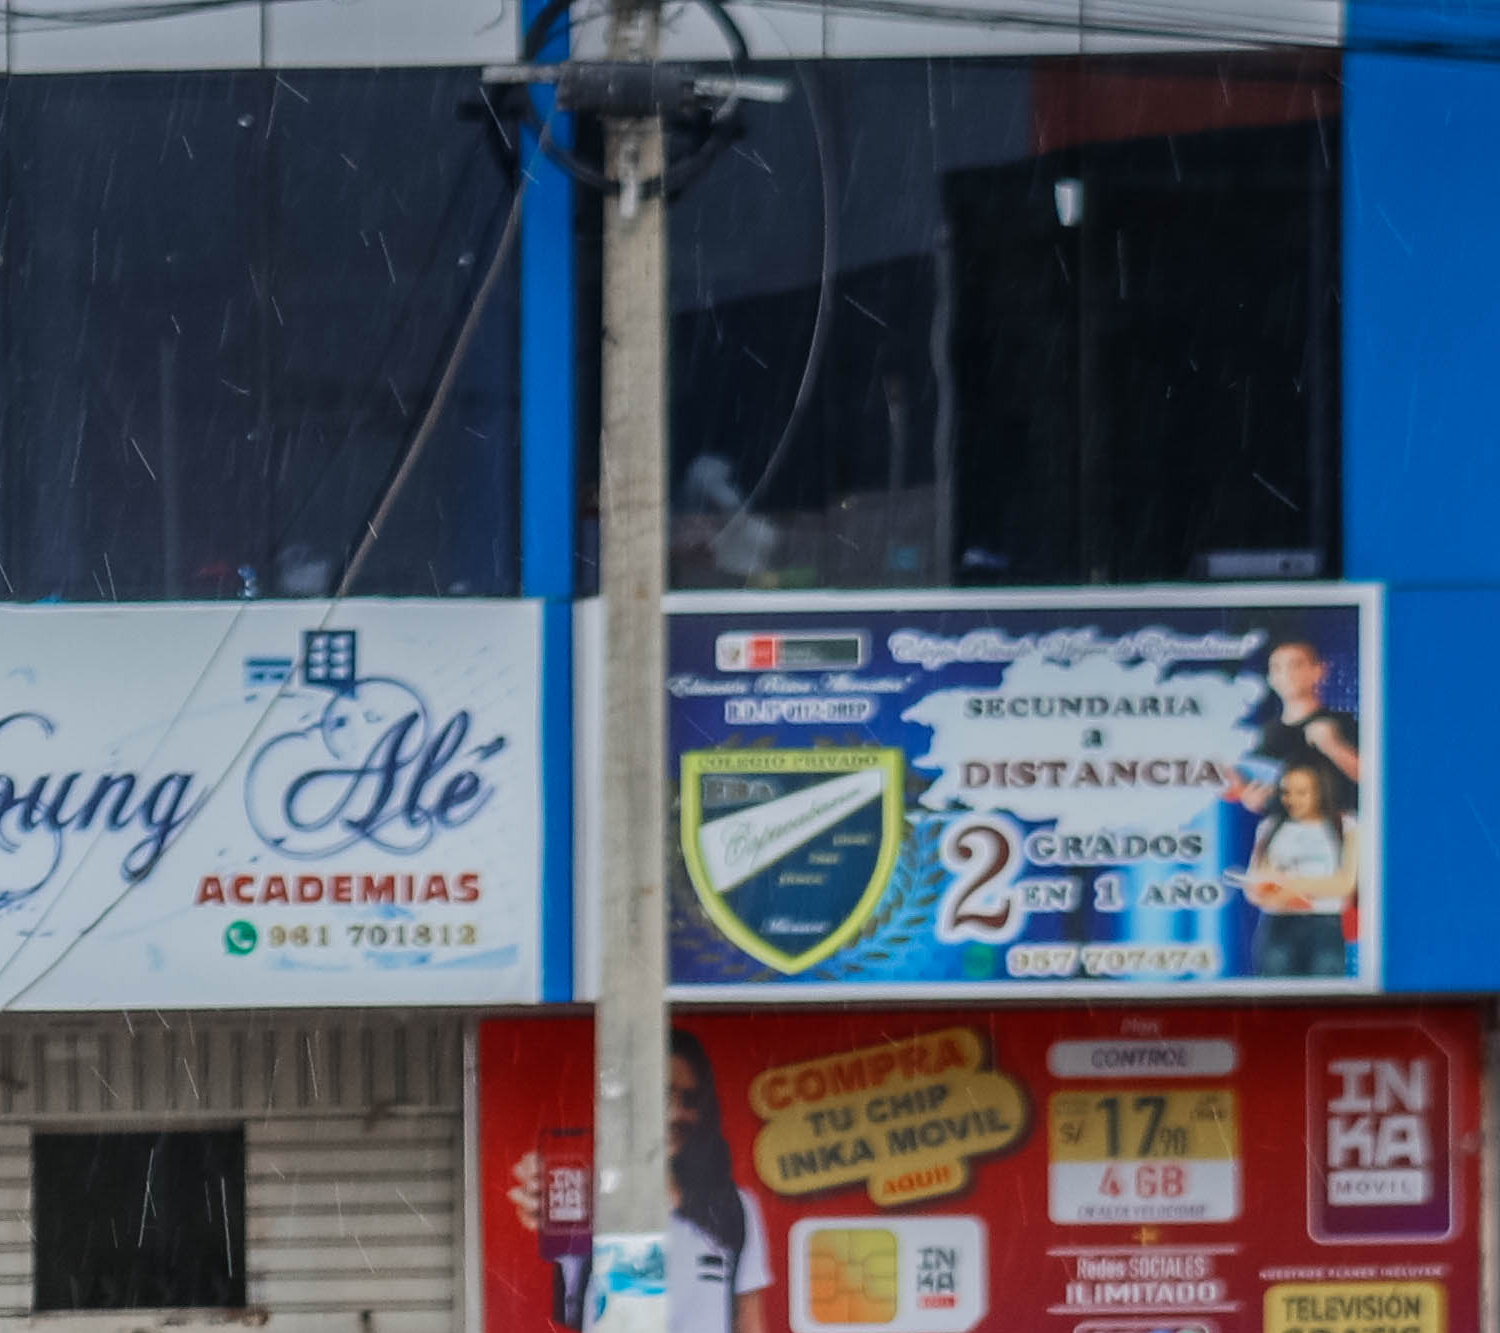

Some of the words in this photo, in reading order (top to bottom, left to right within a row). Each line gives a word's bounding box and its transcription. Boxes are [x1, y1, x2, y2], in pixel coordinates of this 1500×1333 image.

[963, 696, 1203, 719] SECUNDARIA
[962, 759, 1224, 789] DISTANCIA
[194, 871, 482, 905] ACADEMIAS
[950, 823, 1012, 931] 2
[1028, 833, 1204, 859] GRADOS
[1020, 884, 1072, 904] EN
[1097, 881, 1118, 903] 1
[1143, 876, 1221, 903] AÑO
[760, 1036, 968, 1111] COMPRA
[1090, 1046, 1189, 1068] CONTROL
[1327, 1059, 1428, 1113] IN
[806, 1105, 854, 1137] TU
[865, 1083, 951, 1123] CHIP
[777, 1137, 876, 1181] INKA
[886, 1105, 1012, 1156] MOVIL
[1326, 1116, 1426, 1168] KA
[1099, 1164, 1123, 1197] 4
[1135, 1164, 1186, 1198] GB
[1335, 1180, 1412, 1196] MOVIL
[1129, 1255, 1208, 1279] SOCIALES
[1066, 1281, 1220, 1306] ILIMITADO
[1282, 1289, 1422, 1321] TELEVISIÓN
